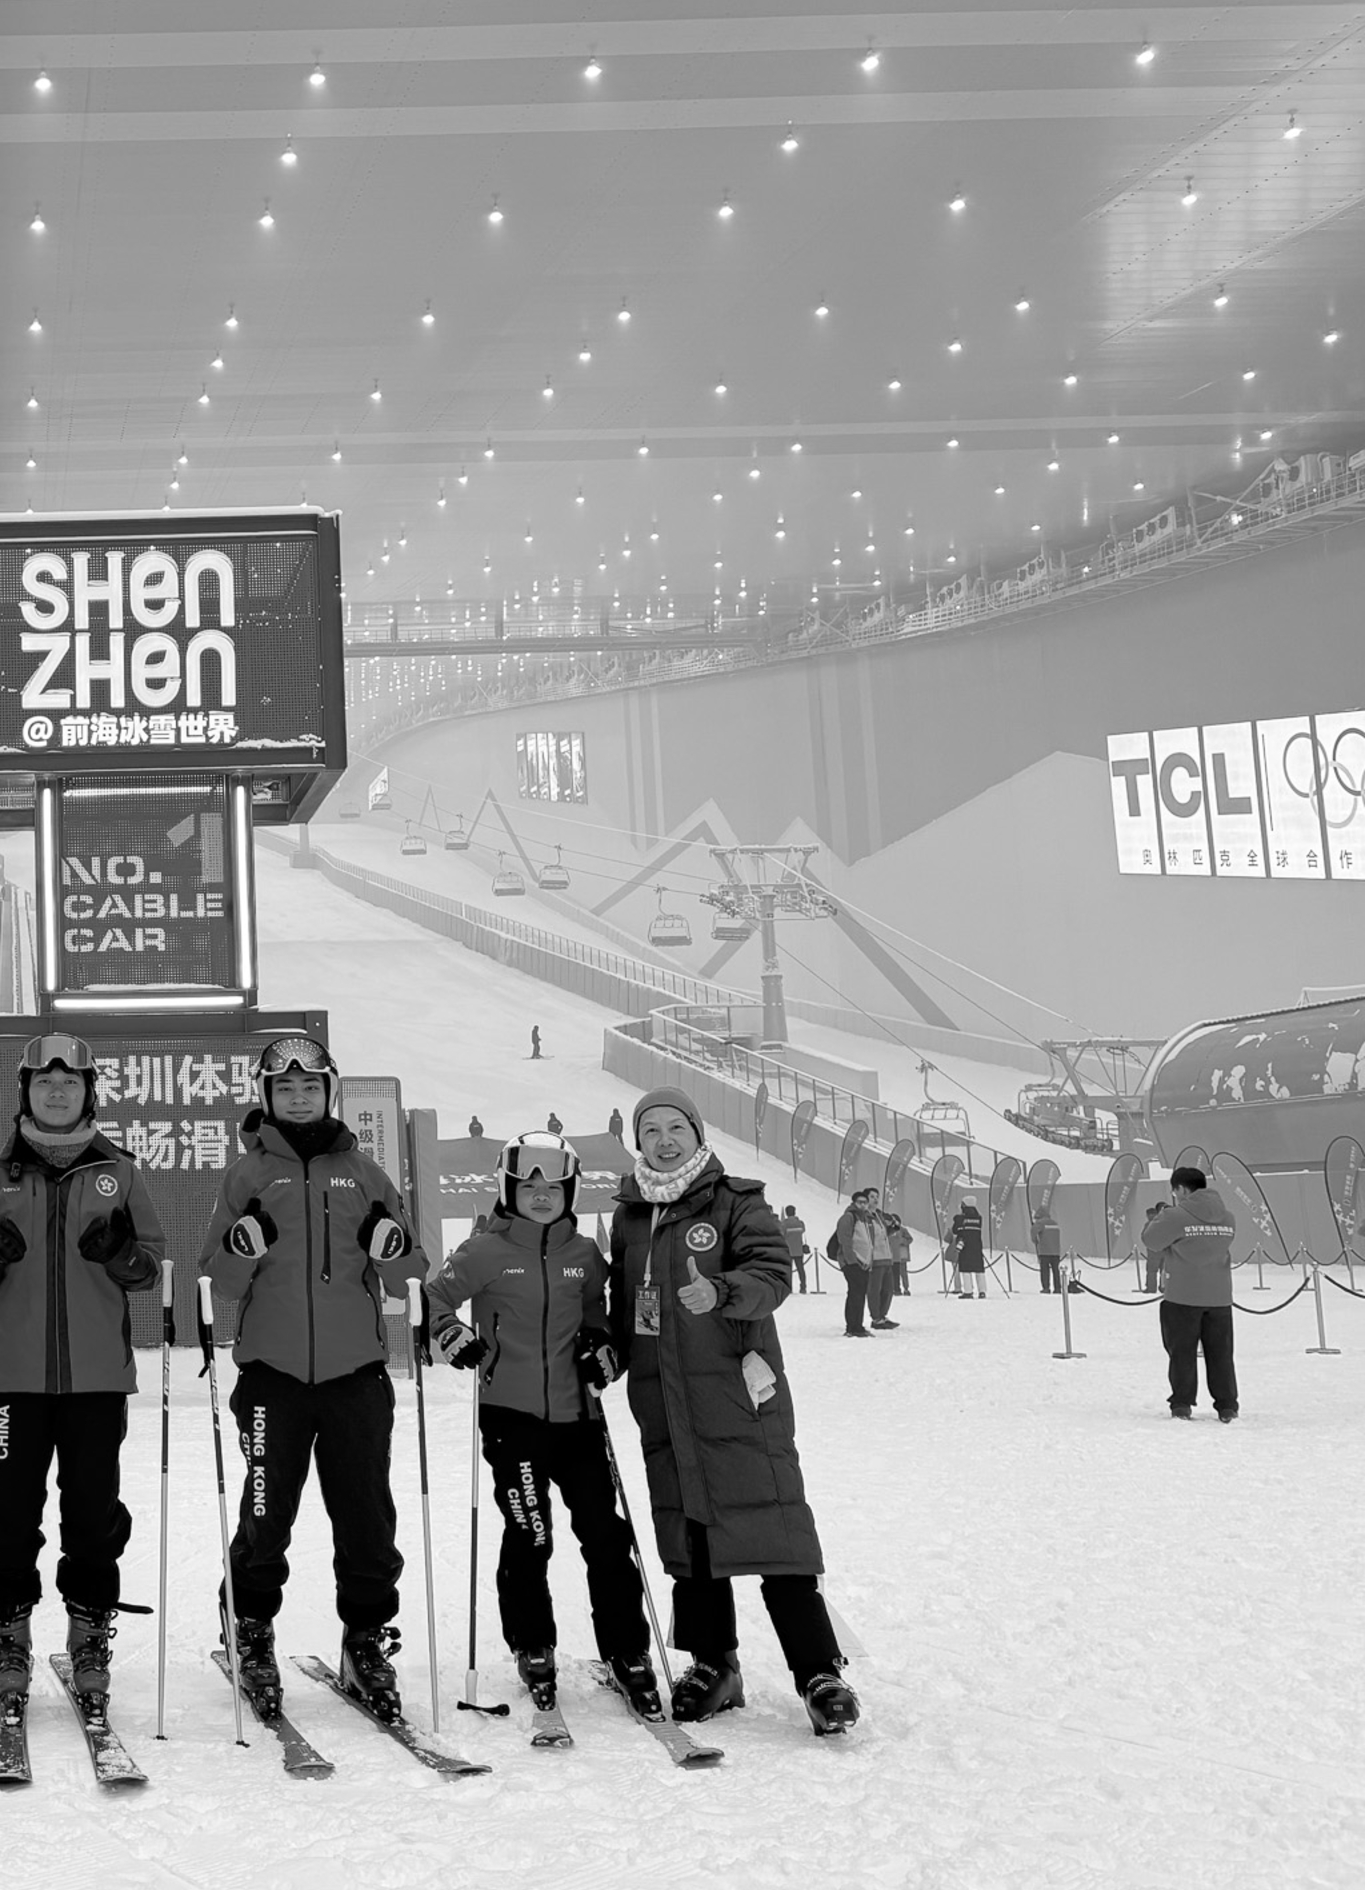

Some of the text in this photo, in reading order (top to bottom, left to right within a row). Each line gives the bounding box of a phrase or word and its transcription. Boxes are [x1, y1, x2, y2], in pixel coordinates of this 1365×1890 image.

[60, 711, 240, 747] 前海冰雪世界
[1111, 751, 1253, 819] TCL
[62, 855, 163, 885] NO.
[63, 893, 225, 919] CABLE
[63, 927, 167, 953] CAR
[330, 1176, 356, 1189] HKG
[563, 1267, 585, 1278] HKG
[253, 1405, 267, 1518] HONG KONG
[519, 1460, 539, 1508] HONG
